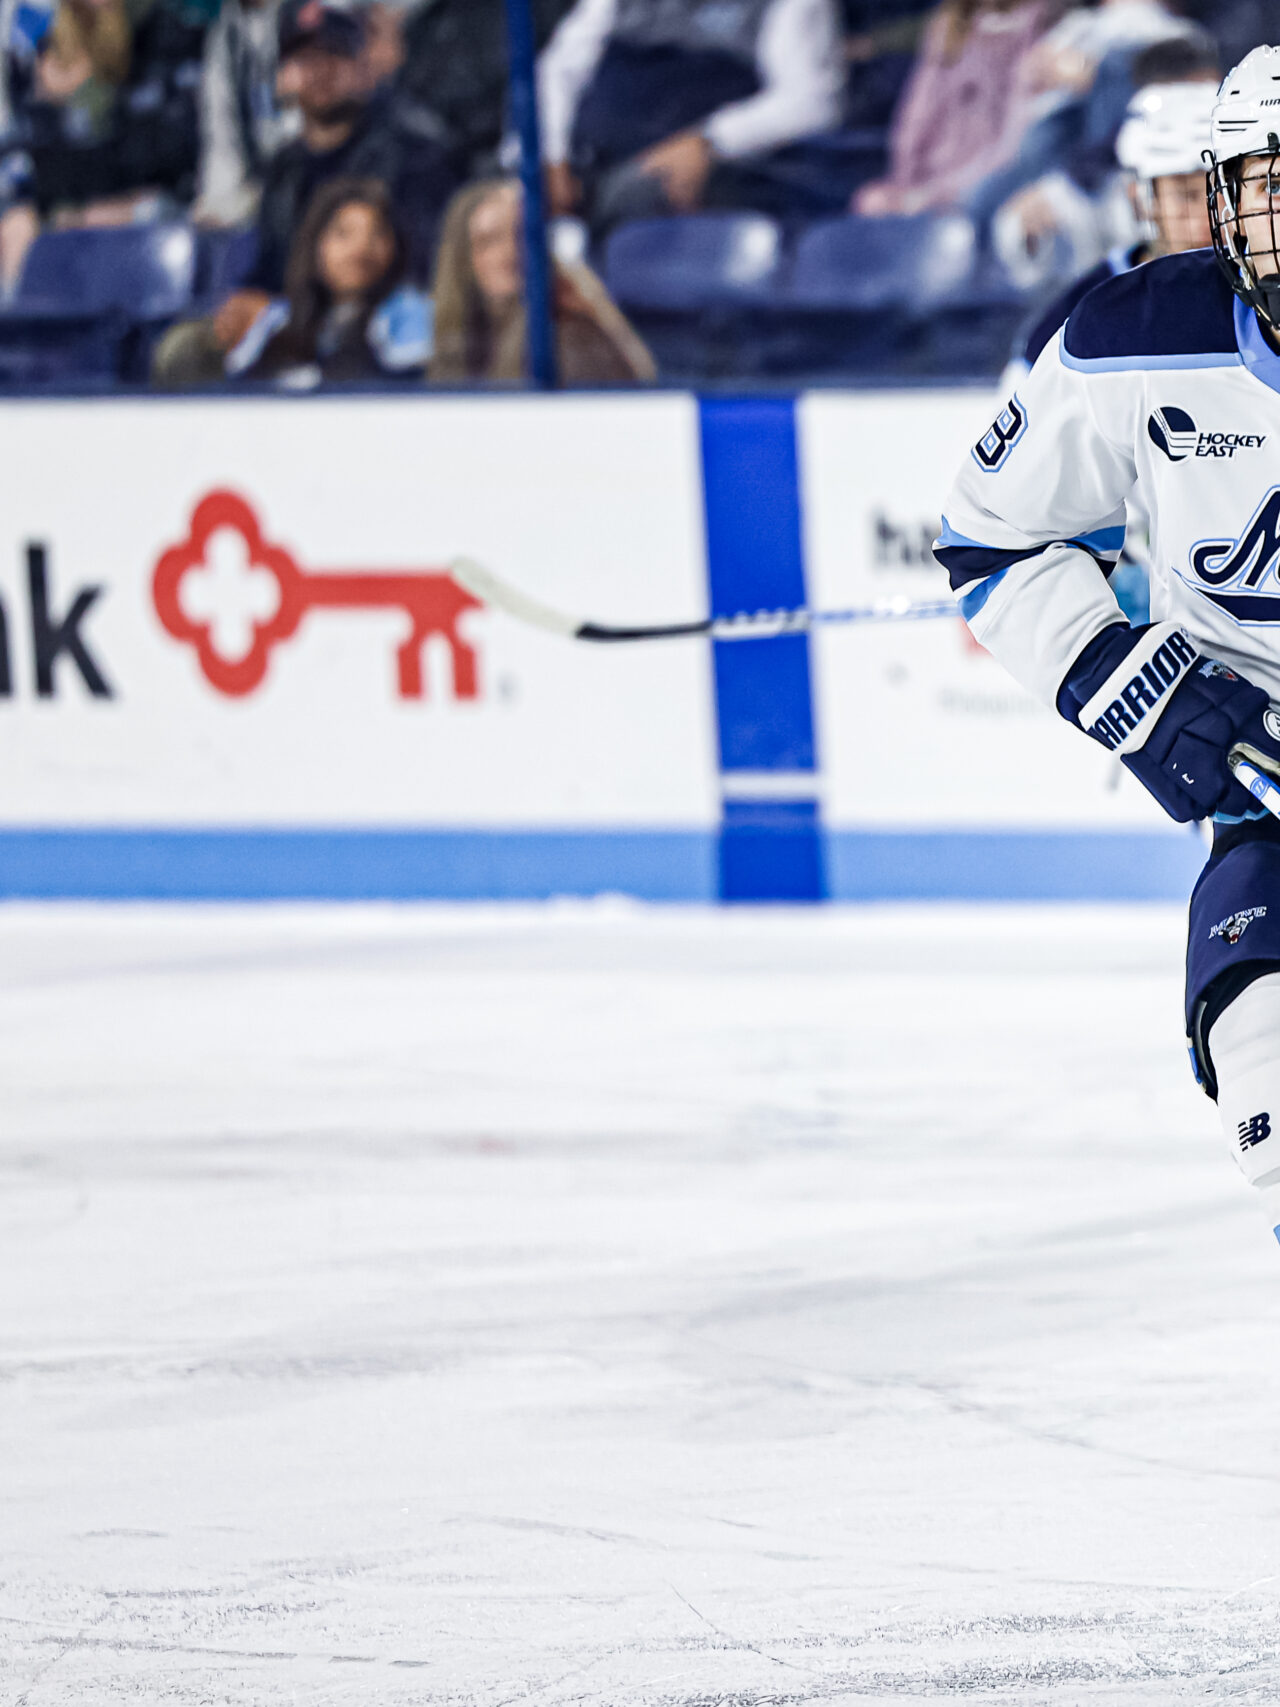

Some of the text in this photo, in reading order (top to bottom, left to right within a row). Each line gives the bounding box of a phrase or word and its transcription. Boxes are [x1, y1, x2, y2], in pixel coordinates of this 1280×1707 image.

[1198, 432, 1266, 448] HOCKEY
[1195, 445, 1238, 458] EAST
[1088, 630, 1198, 750] ARRIOR
